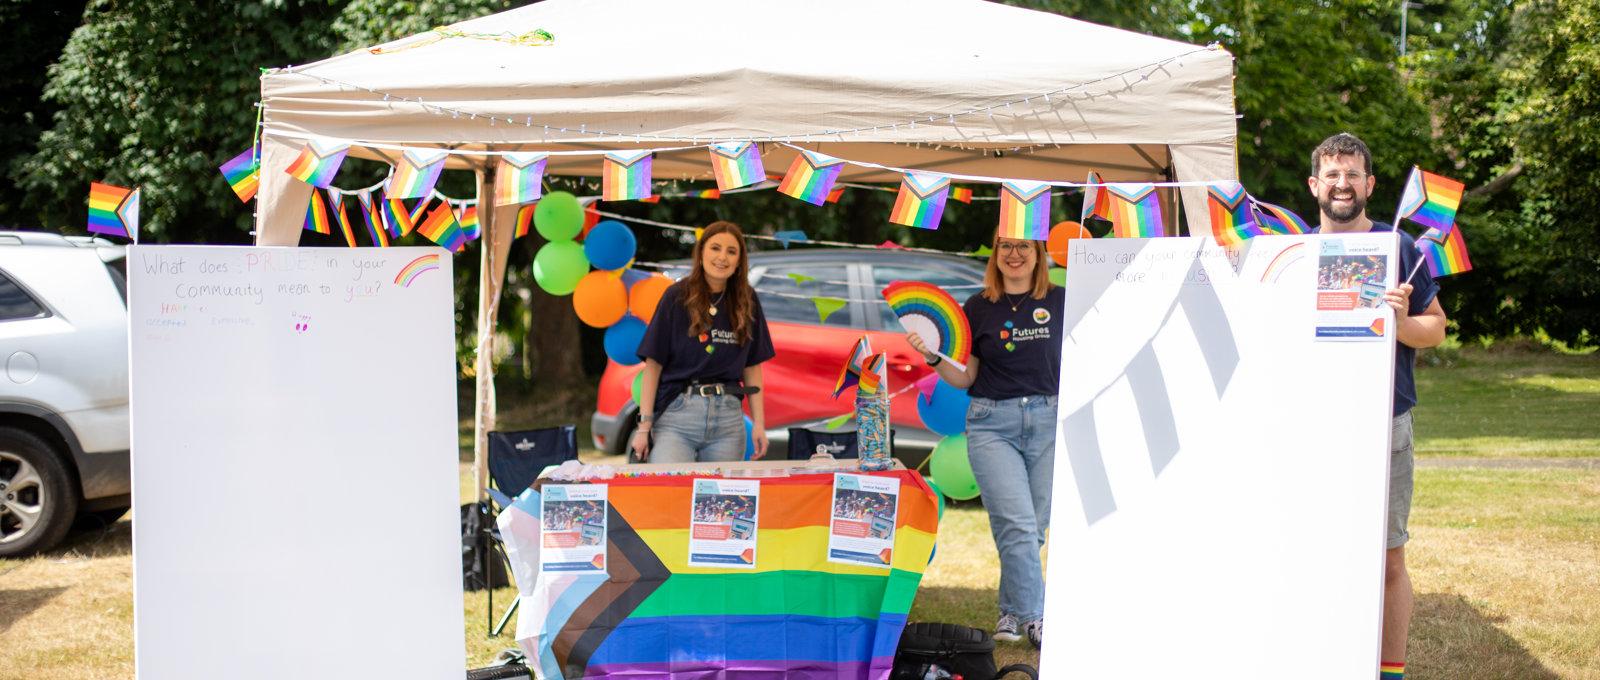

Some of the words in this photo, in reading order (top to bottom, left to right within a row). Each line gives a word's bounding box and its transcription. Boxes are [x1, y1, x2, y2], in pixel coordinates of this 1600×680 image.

[1073, 248, 1106, 265] How
[1115, 251, 1137, 265] can
[142, 252, 187, 275] What
[199, 257, 229, 273] does
[246, 250, 311, 273] PRIDE
[326, 256, 338, 268] in
[352, 256, 388, 281] your
[277, 282, 312, 294] mean
[319, 282, 331, 294] to
[1012, 327, 1050, 337] Futures
